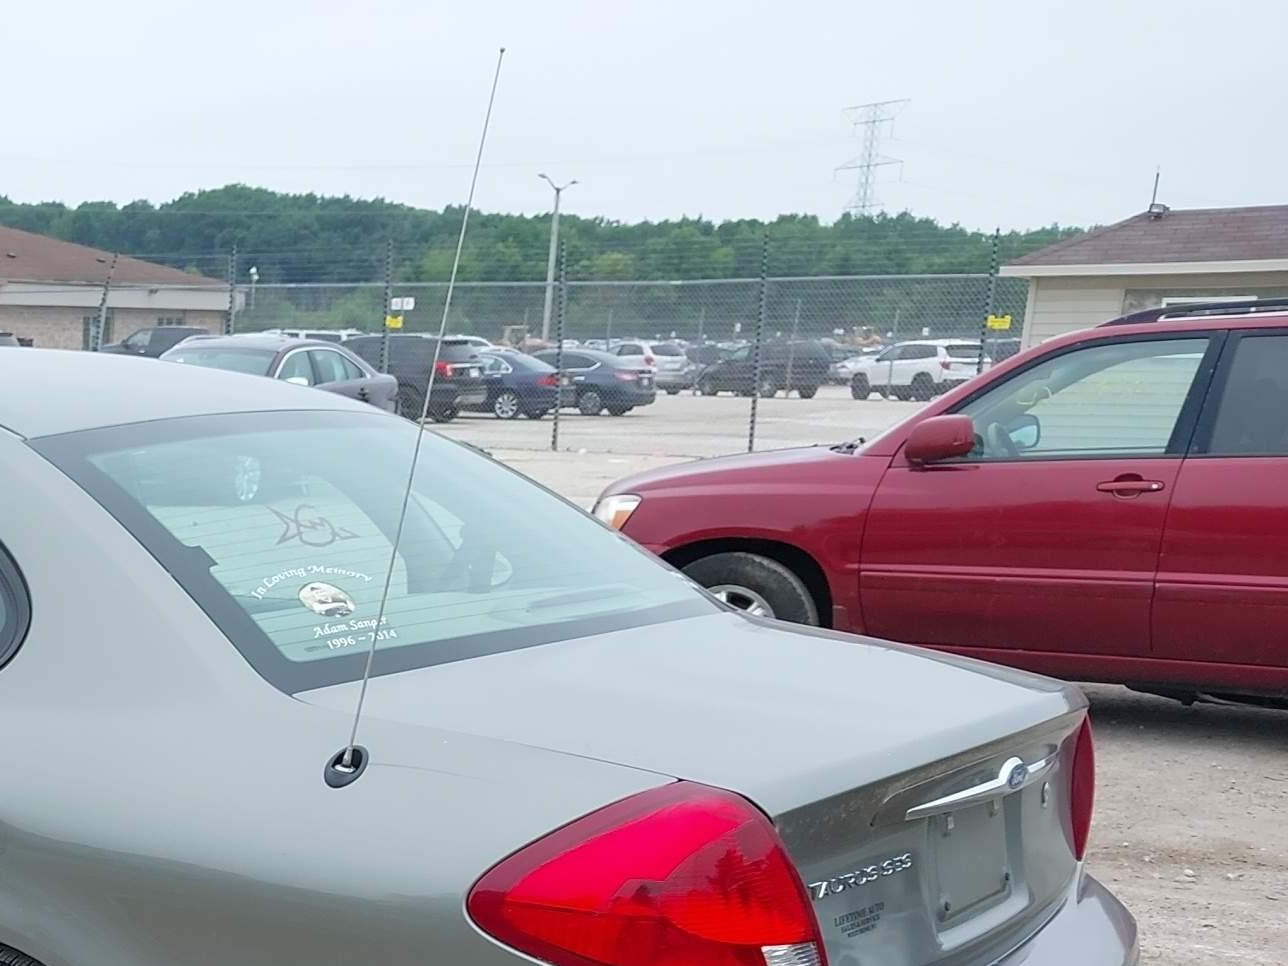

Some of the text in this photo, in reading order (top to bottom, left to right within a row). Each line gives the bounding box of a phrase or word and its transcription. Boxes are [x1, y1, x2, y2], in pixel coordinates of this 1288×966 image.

[251, 565, 373, 600] In Loving Memory
[313, 623, 349, 638] Adam
[327, 635, 356, 650] 1996
[808, 853, 912, 900] TAURUS SES
